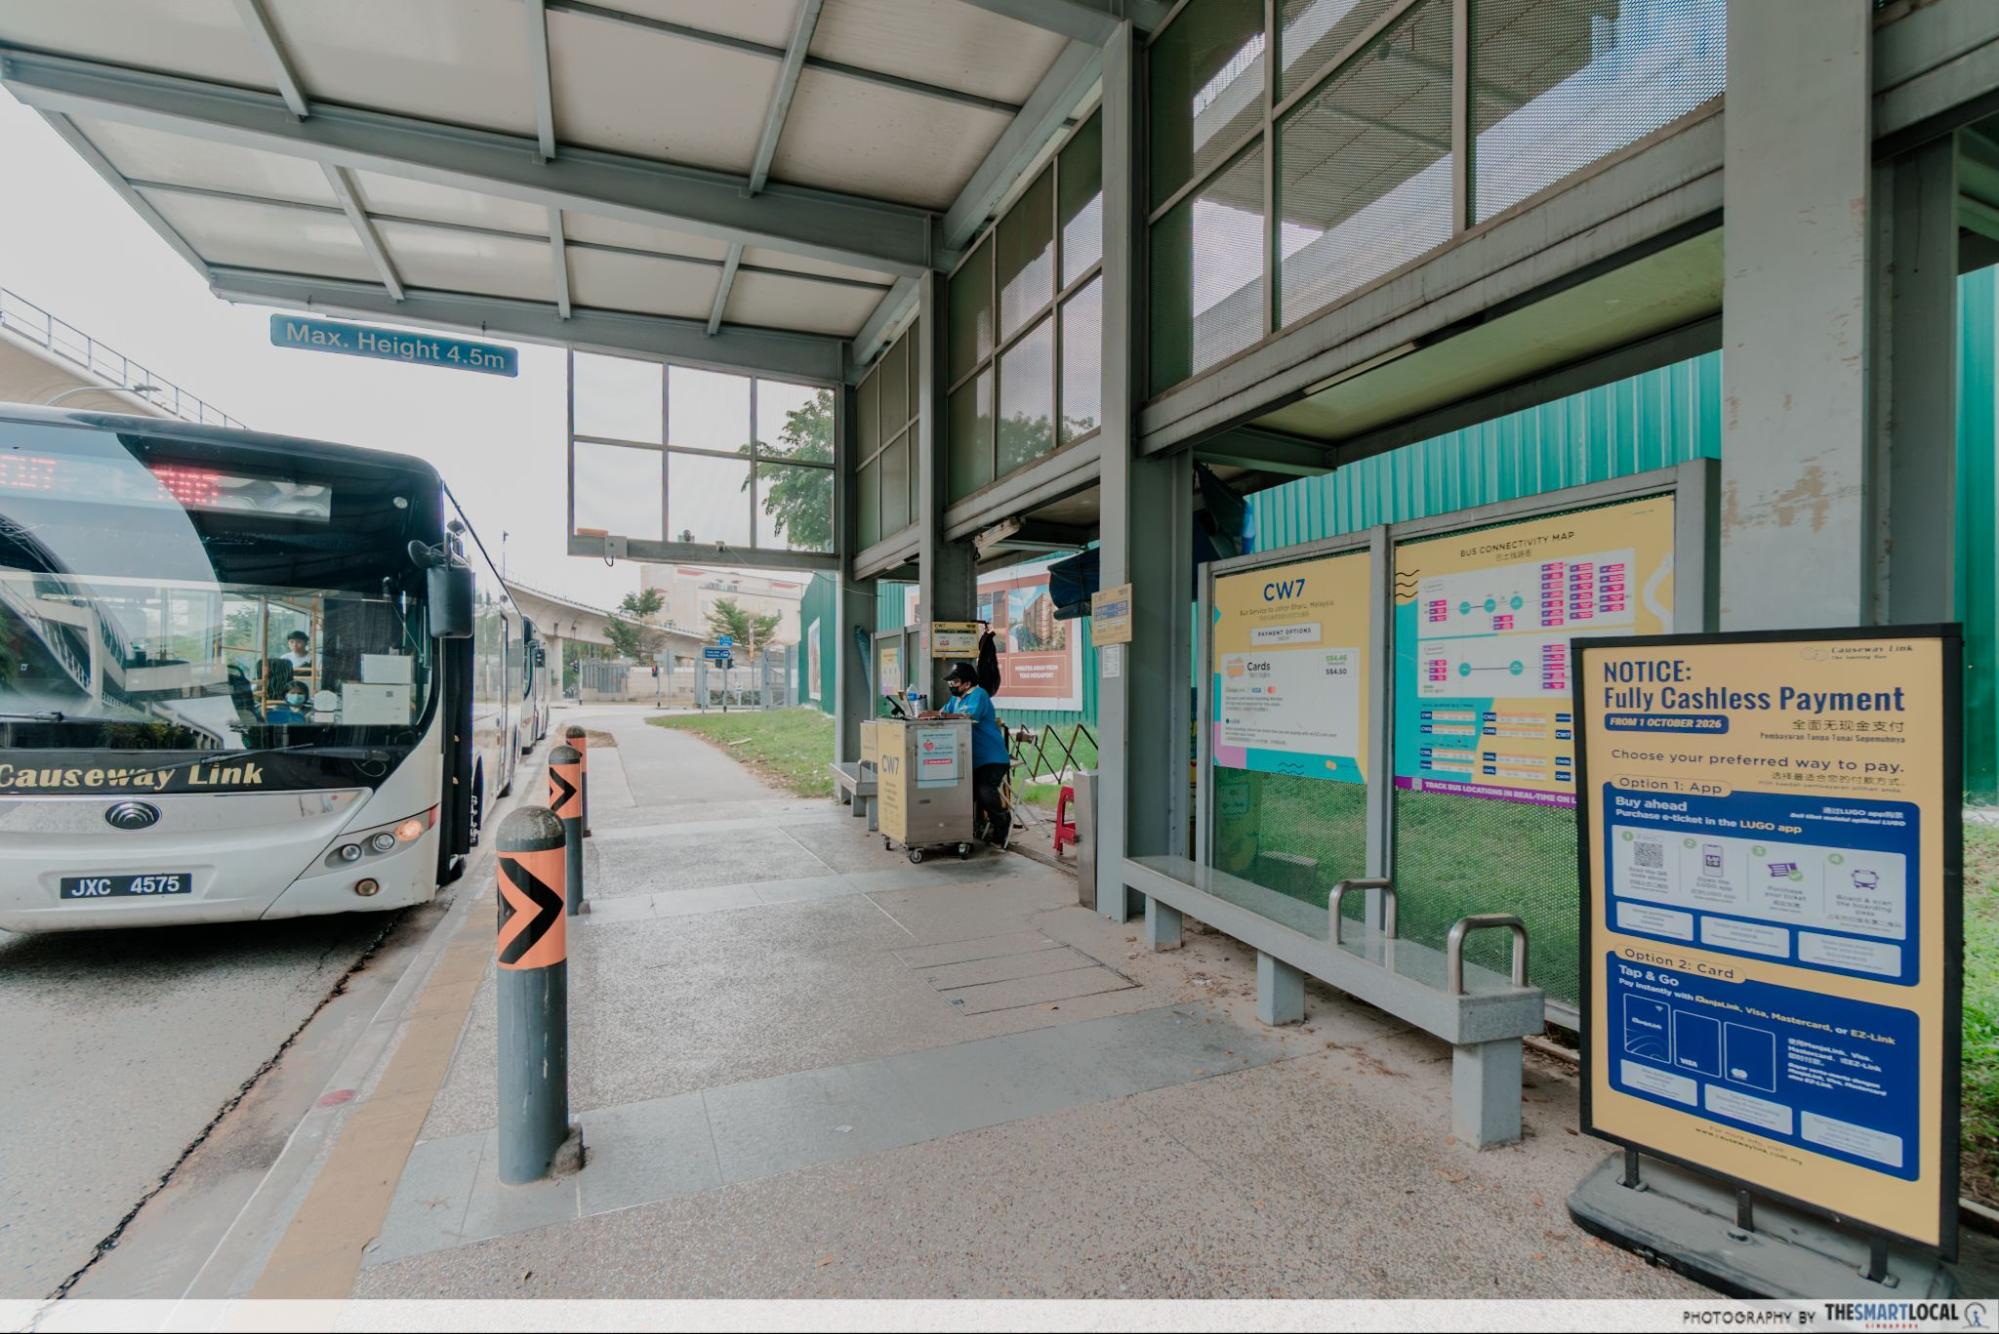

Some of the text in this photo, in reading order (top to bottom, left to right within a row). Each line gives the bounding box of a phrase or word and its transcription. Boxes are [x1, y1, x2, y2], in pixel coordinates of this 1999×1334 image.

[287, 322, 505, 369] Max. Height 4.5m
[1460, 531, 1575, 557] BUS CONNECTIVITY MAP
[1263, 578, 1306, 601] CW7
[1285, 627, 1312, 635] OPTIONS
[1247, 661, 1271, 671] Cards
[1604, 660, 1691, 682] NOTICE:
[1605, 686, 1905, 714] Fully Cashless Payment
[1610, 717, 1637, 726] FROM
[1647, 718, 1694, 728] OCTOBER
[1792, 719, 1905, 733] 全面无现金支付
[882, 754, 900, 776] CW7
[1611, 749, 1905, 774] Choose your preferred way to pay.
[0, 762, 264, 790] Causeway Link
[1619, 777, 1722, 795] Option 1: App
[1425, 781, 1447, 790] TRACK
[1448, 783, 1462, 791] BUS
[1462, 785, 1503, 796] LOCATIONS
[1503, 789, 1513, 797] IN
[1513, 791, 1555, 802] REAL-TIME
[1556, 795, 1570, 803] ON
[1615, 796, 1688, 812] Buy ahead
[1615, 809, 1802, 834] Purchase e-ticket in the LUGO app
[71, 876, 180, 897] JXC 4575
[1625, 948, 1734, 979] Option 2: Card
[1618, 964, 1680, 987] Tap & Go
[1618, 977, 1634, 988] Pay
[1636, 981, 1673, 997] instantly
[1674, 990, 1694, 1001] with
[1835, 1027, 1848, 1035] or
[1851, 1029, 1896, 1045] EZ-Link
[1679, 1057, 1698, 1068] VISA
